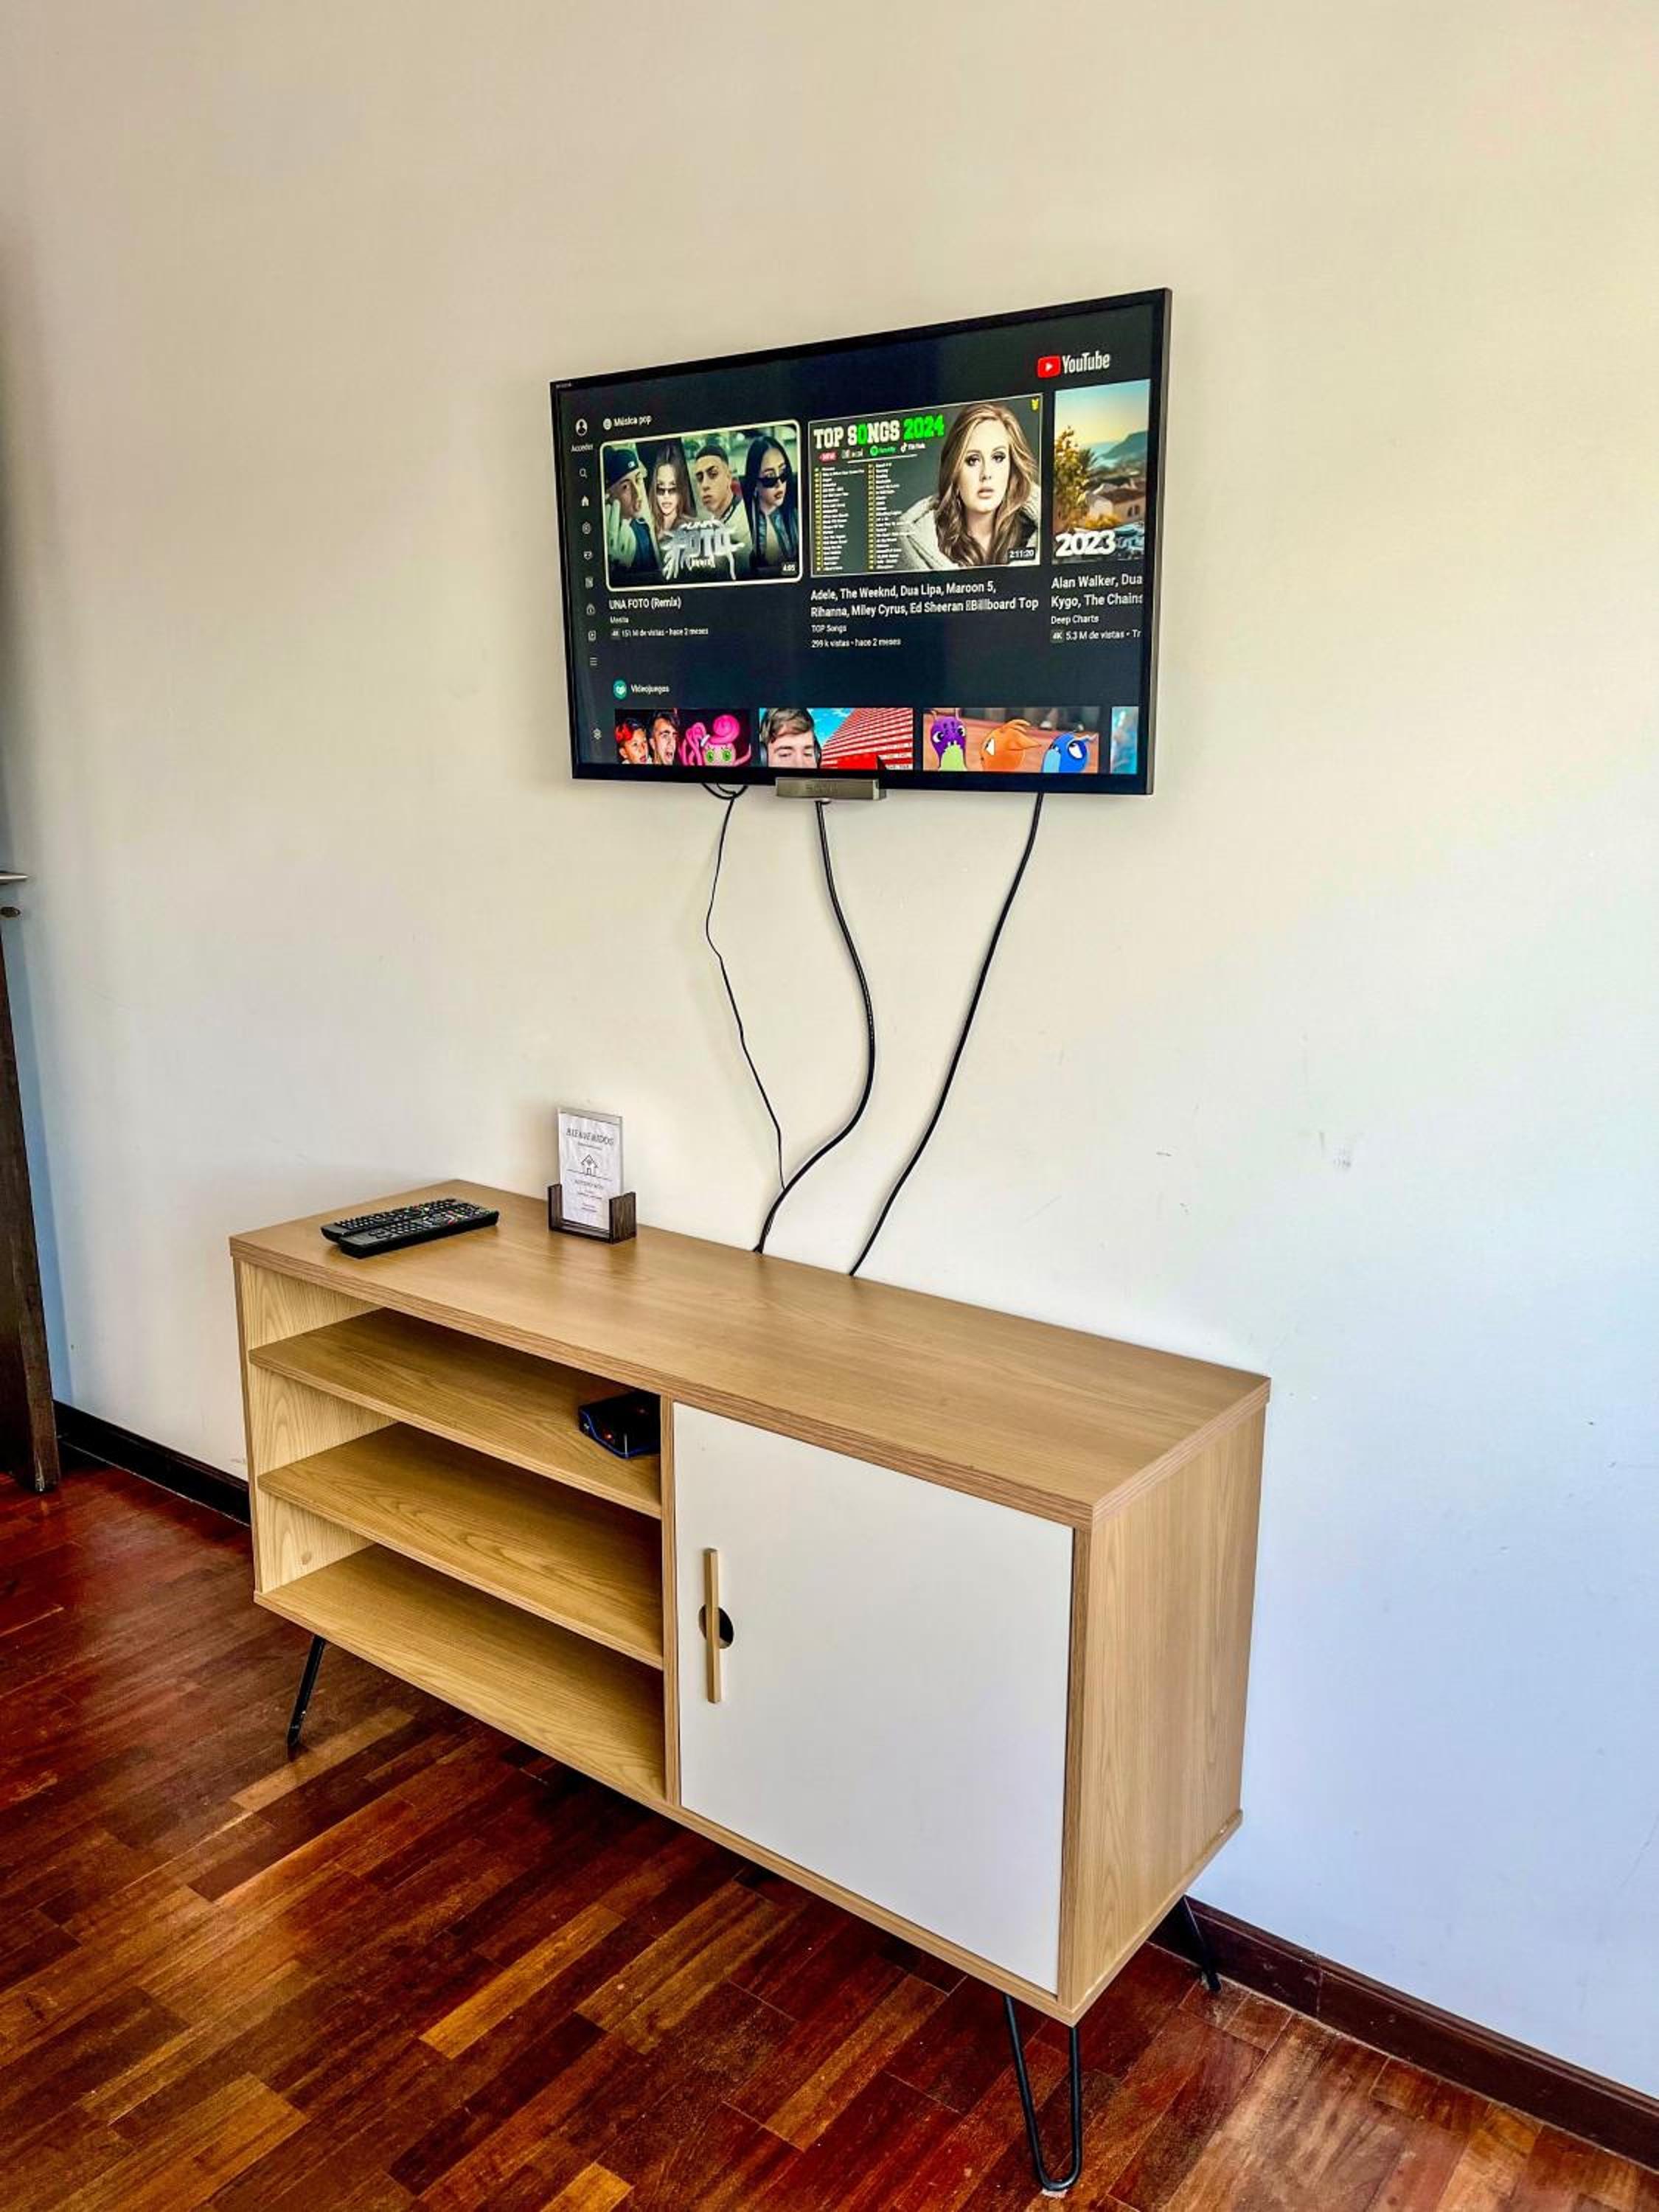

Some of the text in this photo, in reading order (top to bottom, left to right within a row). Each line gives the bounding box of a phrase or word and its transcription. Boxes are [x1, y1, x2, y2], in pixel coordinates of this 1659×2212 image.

[1062, 349, 1110, 374] YouTube
[813, 414, 945, 449] TOP SONGS 2024
[1055, 530, 1116, 557] 2023
[1051, 573, 1143, 589] Alan Walker, Dua
[810, 580, 996, 602] Adele, The Weeknd, Dua Lipa, Maroon 5,
[608, 596, 682, 610] UNA FOTO (Remix)
[810, 606, 849, 618] Rihanna,
[851, 605, 876, 618] Miley
[878, 604, 908, 616] Cyrus,
[909, 602, 922, 613] Ed
[924, 602, 964, 613] Sheeran
[1018, 597, 1039, 611] Top
[1051, 595, 1082, 610] Kygo,
[1084, 593, 1105, 606] The
[1051, 614, 1099, 625] Deep Charts
[855, 639, 872, 647] hace
[872, 638, 877, 647] 2
[1079, 630, 1088, 640] M
[1088, 630, 1099, 639] de
[1100, 629, 1124, 639] vistas
